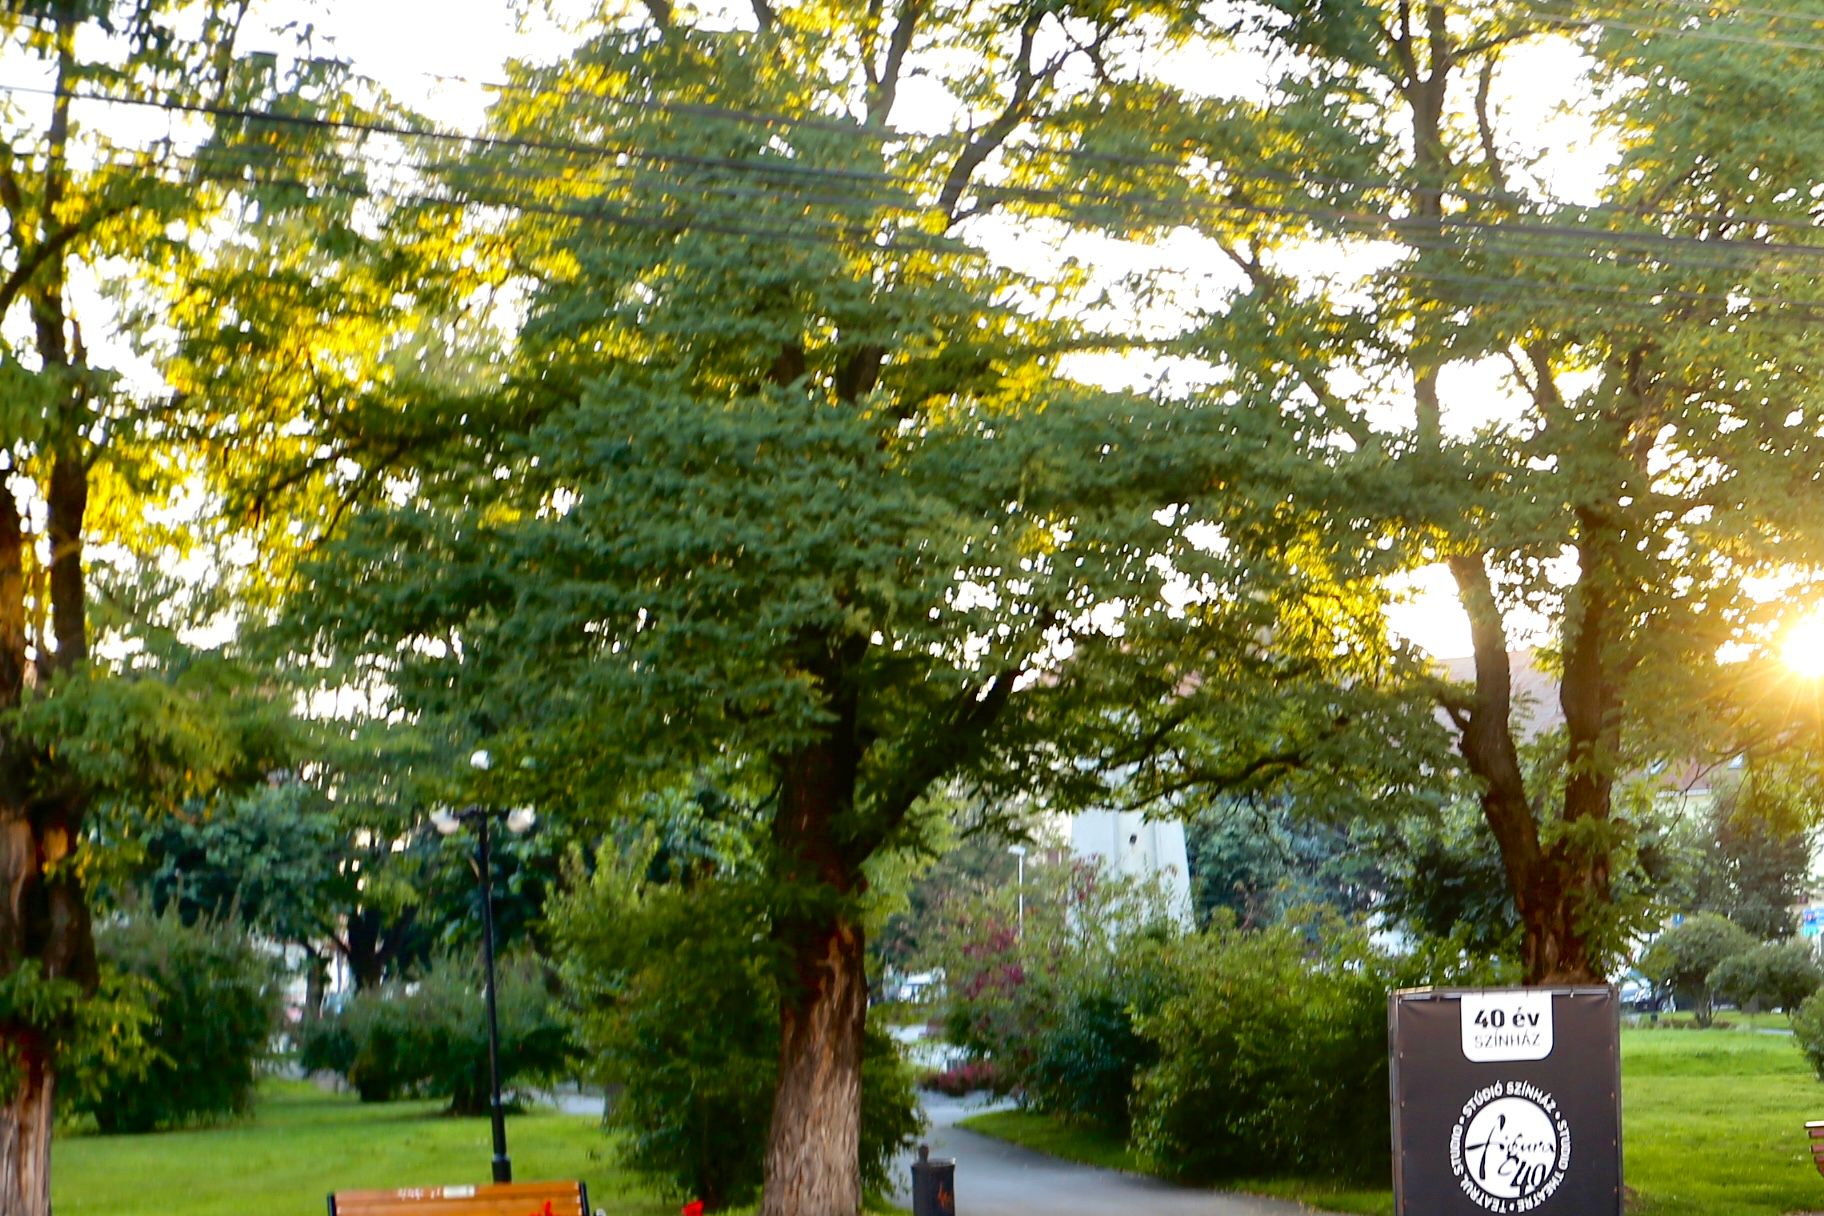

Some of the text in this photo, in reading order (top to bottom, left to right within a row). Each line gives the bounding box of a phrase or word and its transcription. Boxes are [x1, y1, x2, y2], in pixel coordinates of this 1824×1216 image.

[1474, 1006, 1540, 1028] 40 év
[1475, 1030, 1540, 1048] SZÍNHÁZ
[1463, 1080, 1557, 1118] STÚDIÓ SZÍNHÁZ
[1460, 1173, 1507, 1213] TEATRUL
[1510, 1160, 1547, 1198] 40
[1517, 1171, 1564, 1213] THEATRE
